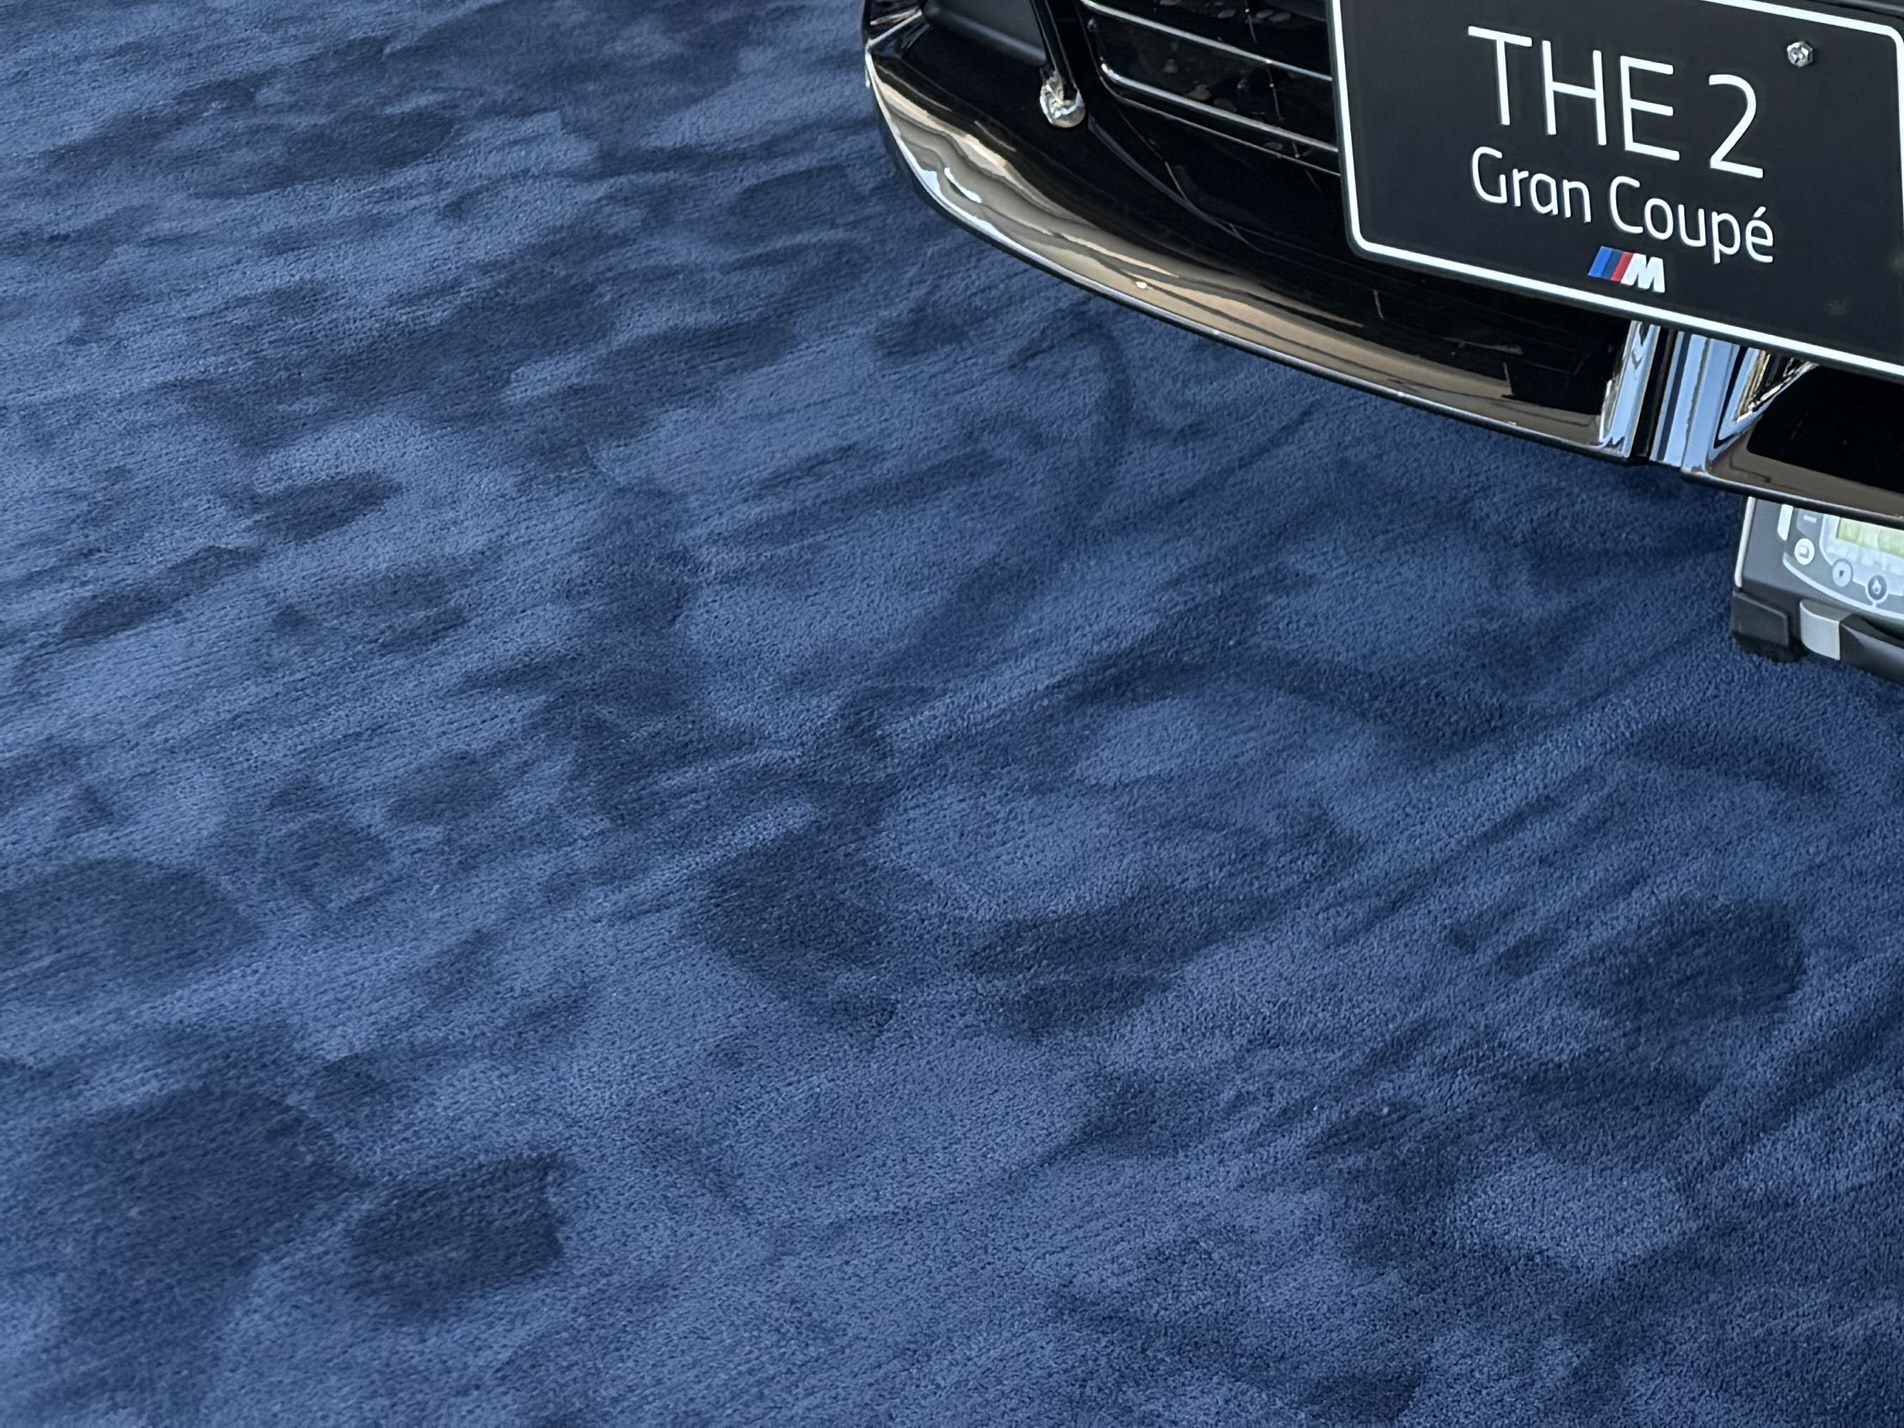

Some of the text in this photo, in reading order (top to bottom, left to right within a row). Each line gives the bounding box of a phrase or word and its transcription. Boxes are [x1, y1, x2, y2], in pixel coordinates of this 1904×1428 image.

[1467, 25, 1765, 179] THE 2
[1471, 146, 1774, 265] Gran Coupé
